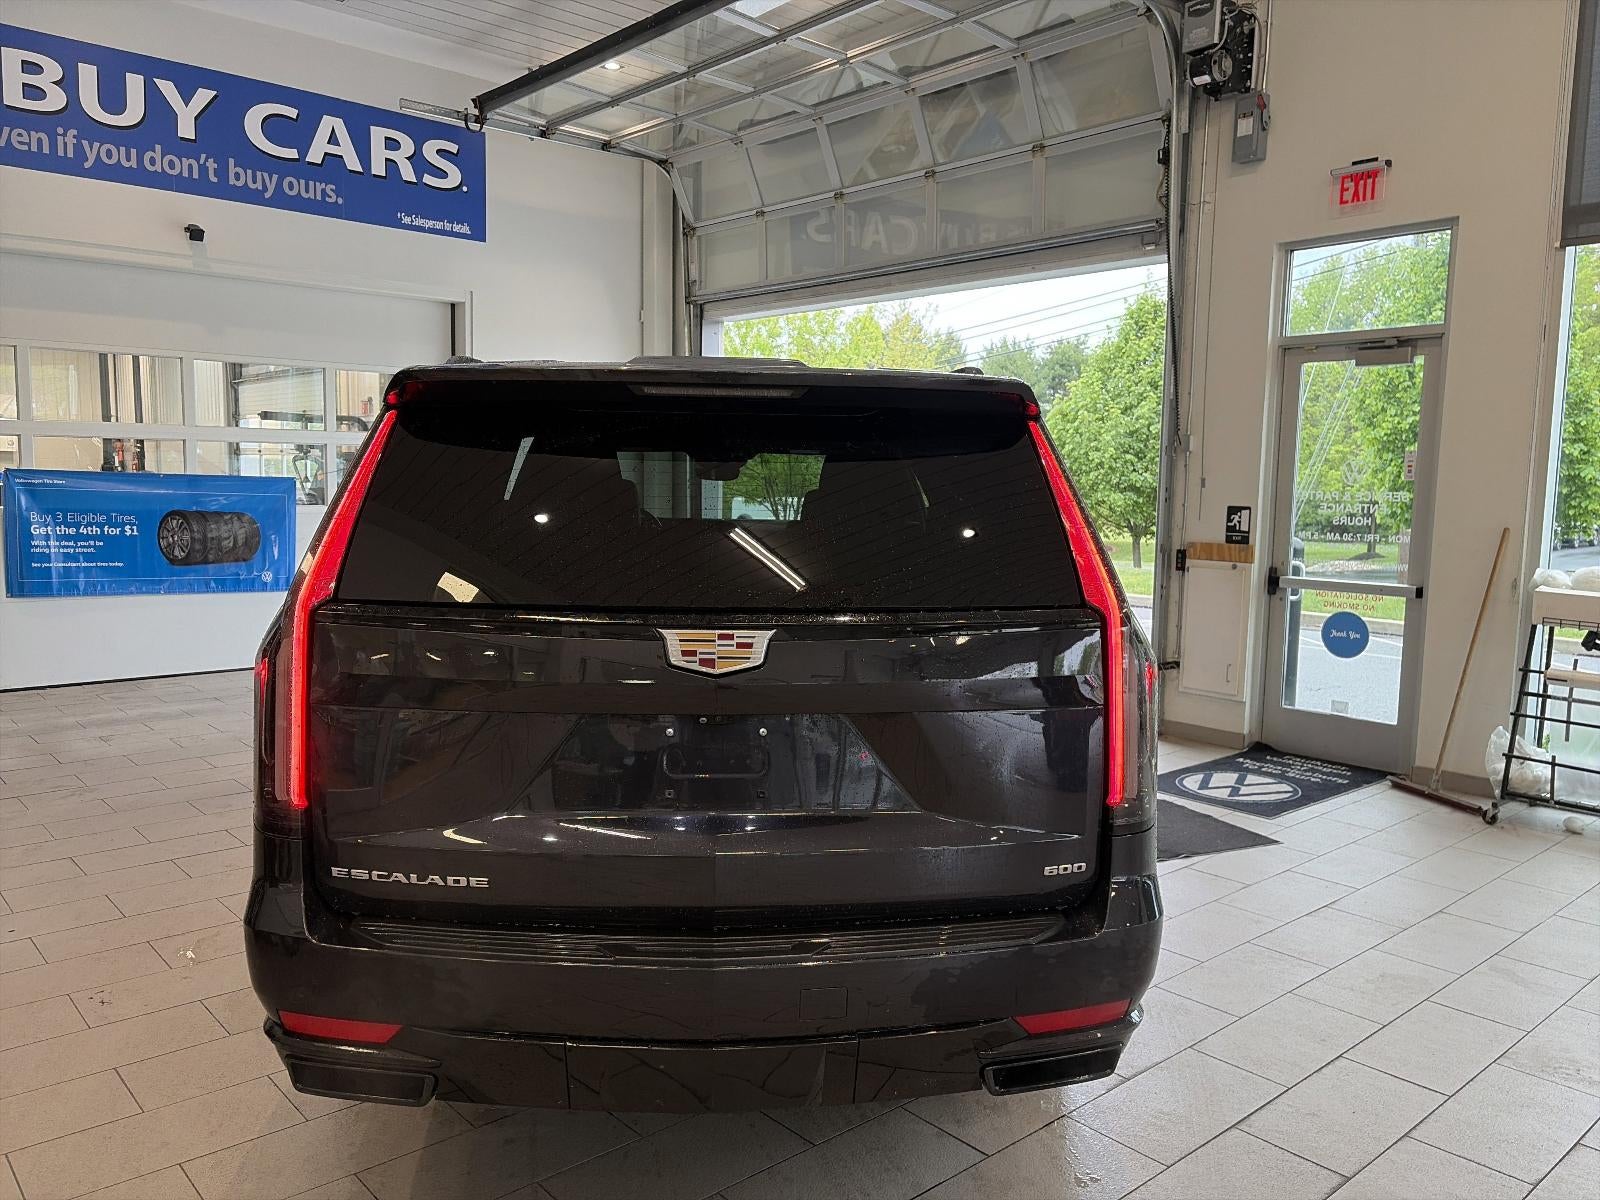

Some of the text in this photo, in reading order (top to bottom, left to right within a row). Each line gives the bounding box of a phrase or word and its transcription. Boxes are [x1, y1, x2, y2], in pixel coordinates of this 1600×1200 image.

[0, 46, 469, 193] BUY CARS.
[56, 127, 78, 158] if
[81, 139, 137, 169] you
[143, 143, 218, 183] don't
[228, 158, 278, 199] buy
[282, 176, 344, 205] ours.
[1339, 169, 1380, 206] EXIT
[401, 212, 412, 225] See
[412, 213, 444, 230] Salesperson
[444, 219, 452, 231] for
[30, 512, 138, 525] Buy 3 Eligible Tires,
[30, 524, 139, 536] Get the 4th for $1
[1329, 629, 1361, 639] Thank You
[330, 866, 489, 888] ESCALADE
[1043, 862, 1087, 876] 600
